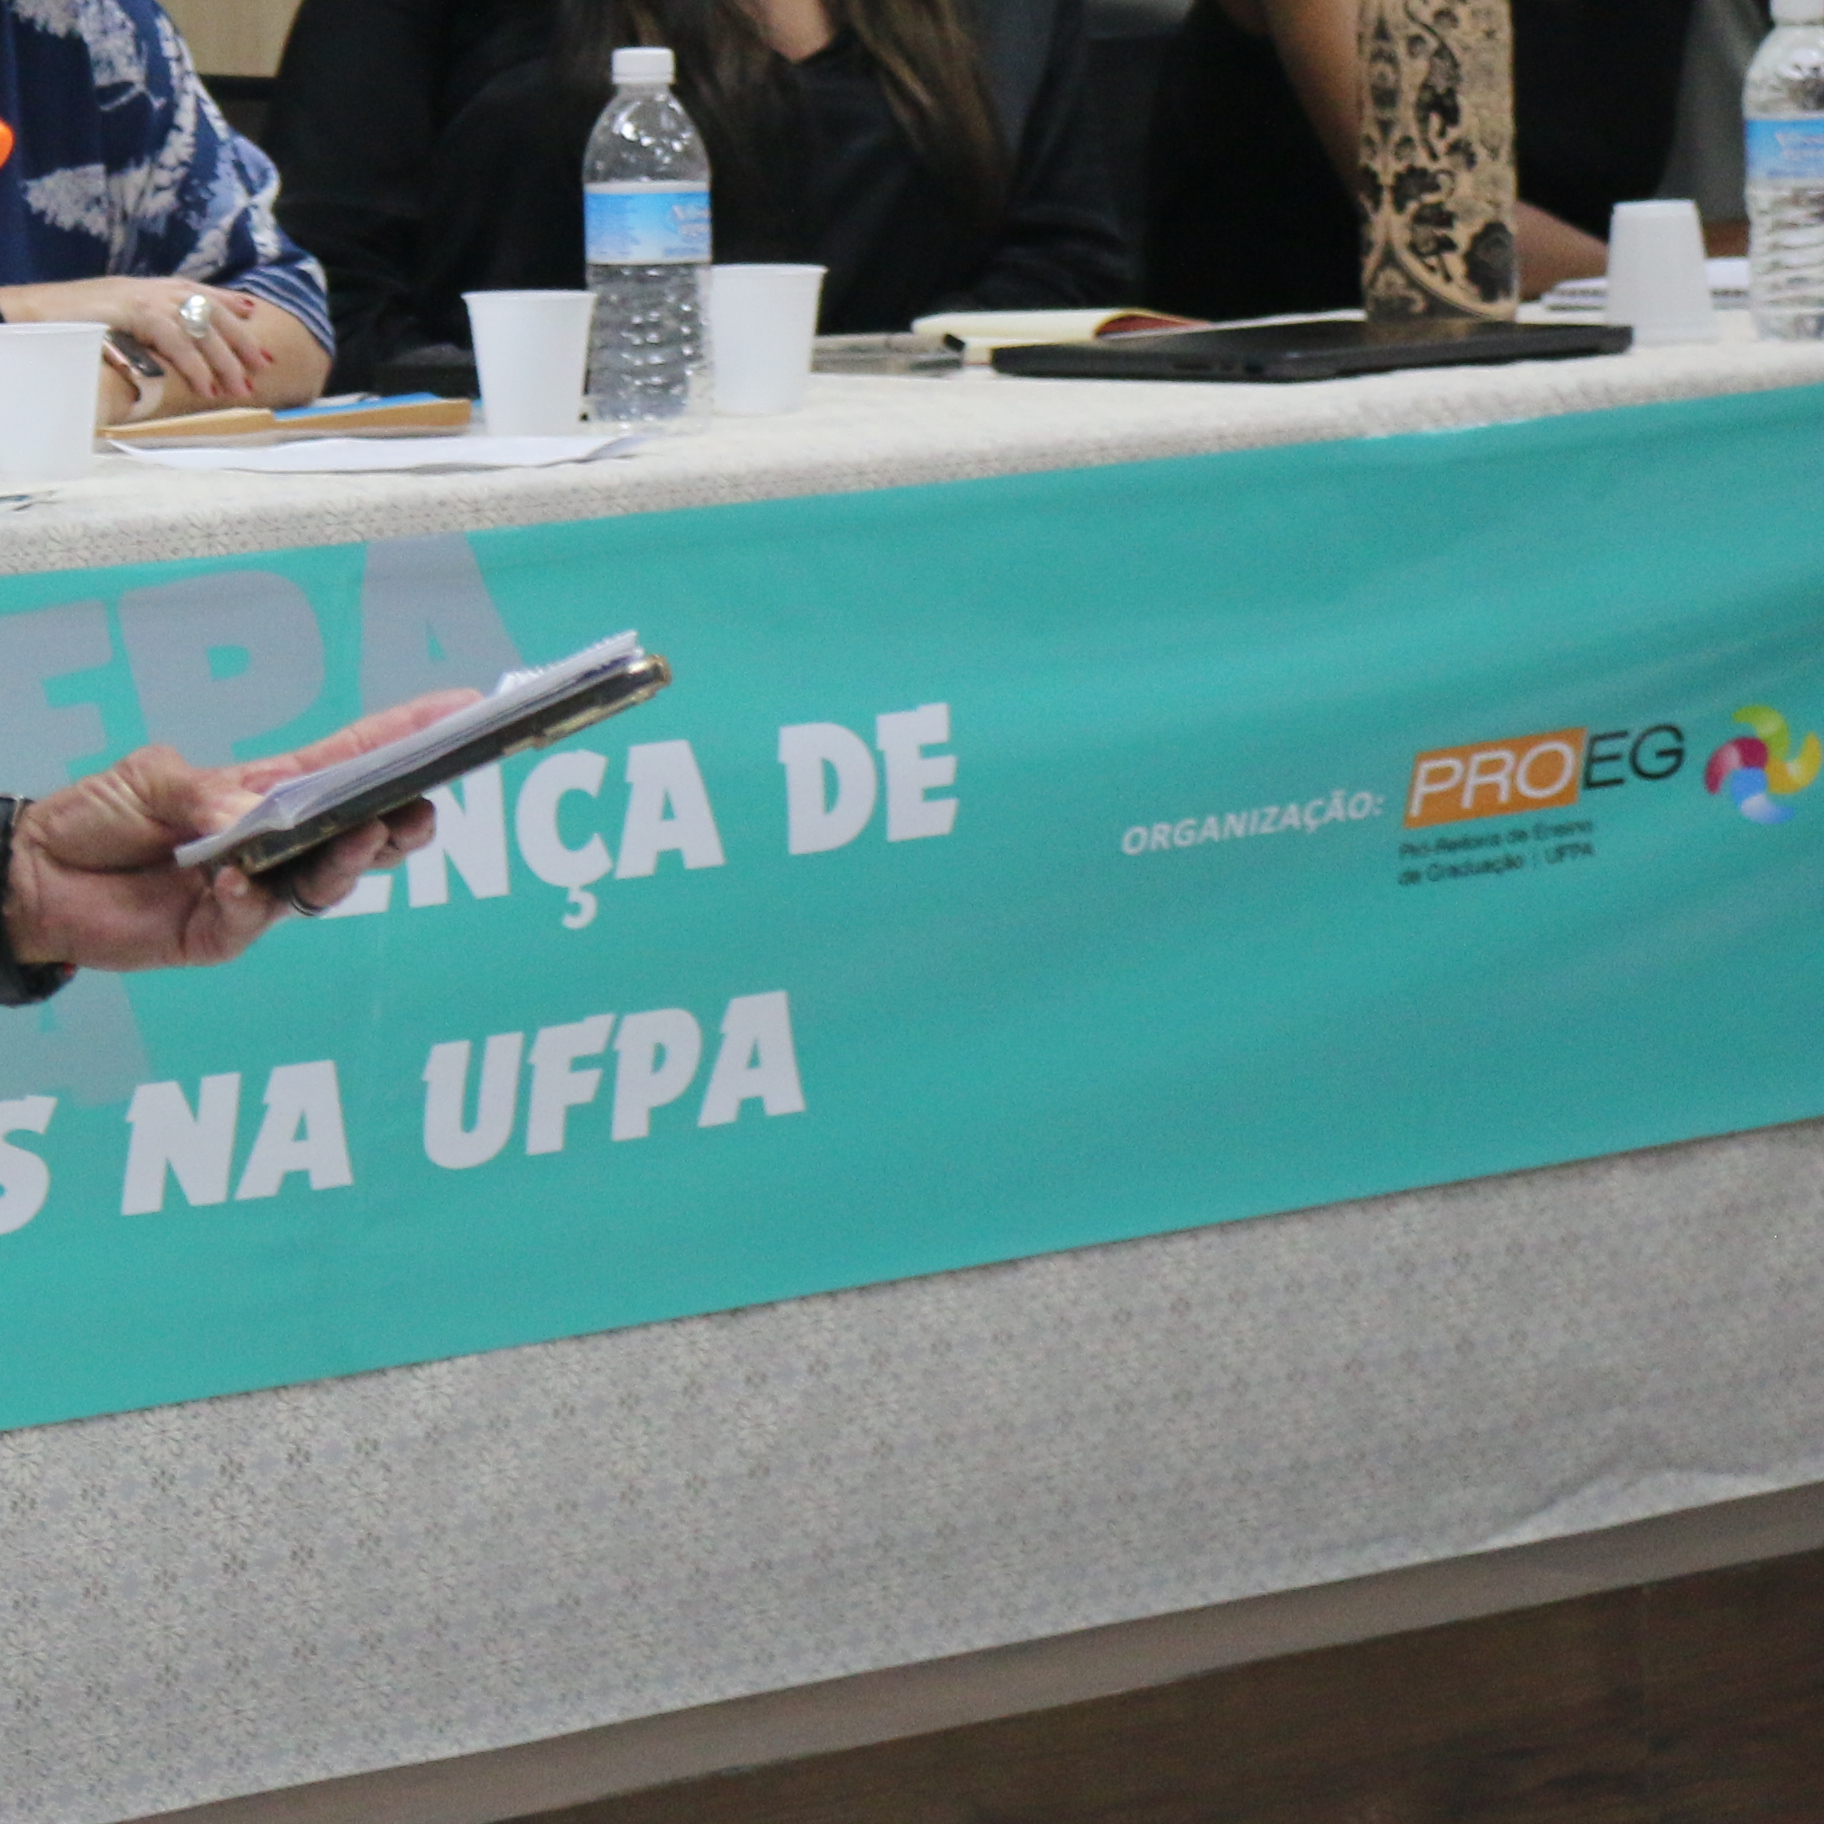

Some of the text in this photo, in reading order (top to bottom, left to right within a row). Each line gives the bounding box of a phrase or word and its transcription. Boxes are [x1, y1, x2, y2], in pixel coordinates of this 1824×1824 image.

[320, 739, 725, 928] NÇA
[778, 702, 958, 855] DE
[1120, 790, 1384, 856] ORGANIZAÇÃO:
[1408, 724, 1685, 818] PROEG
[121, 1060, 353, 1215] NA
[420, 991, 806, 1172] UFPA
